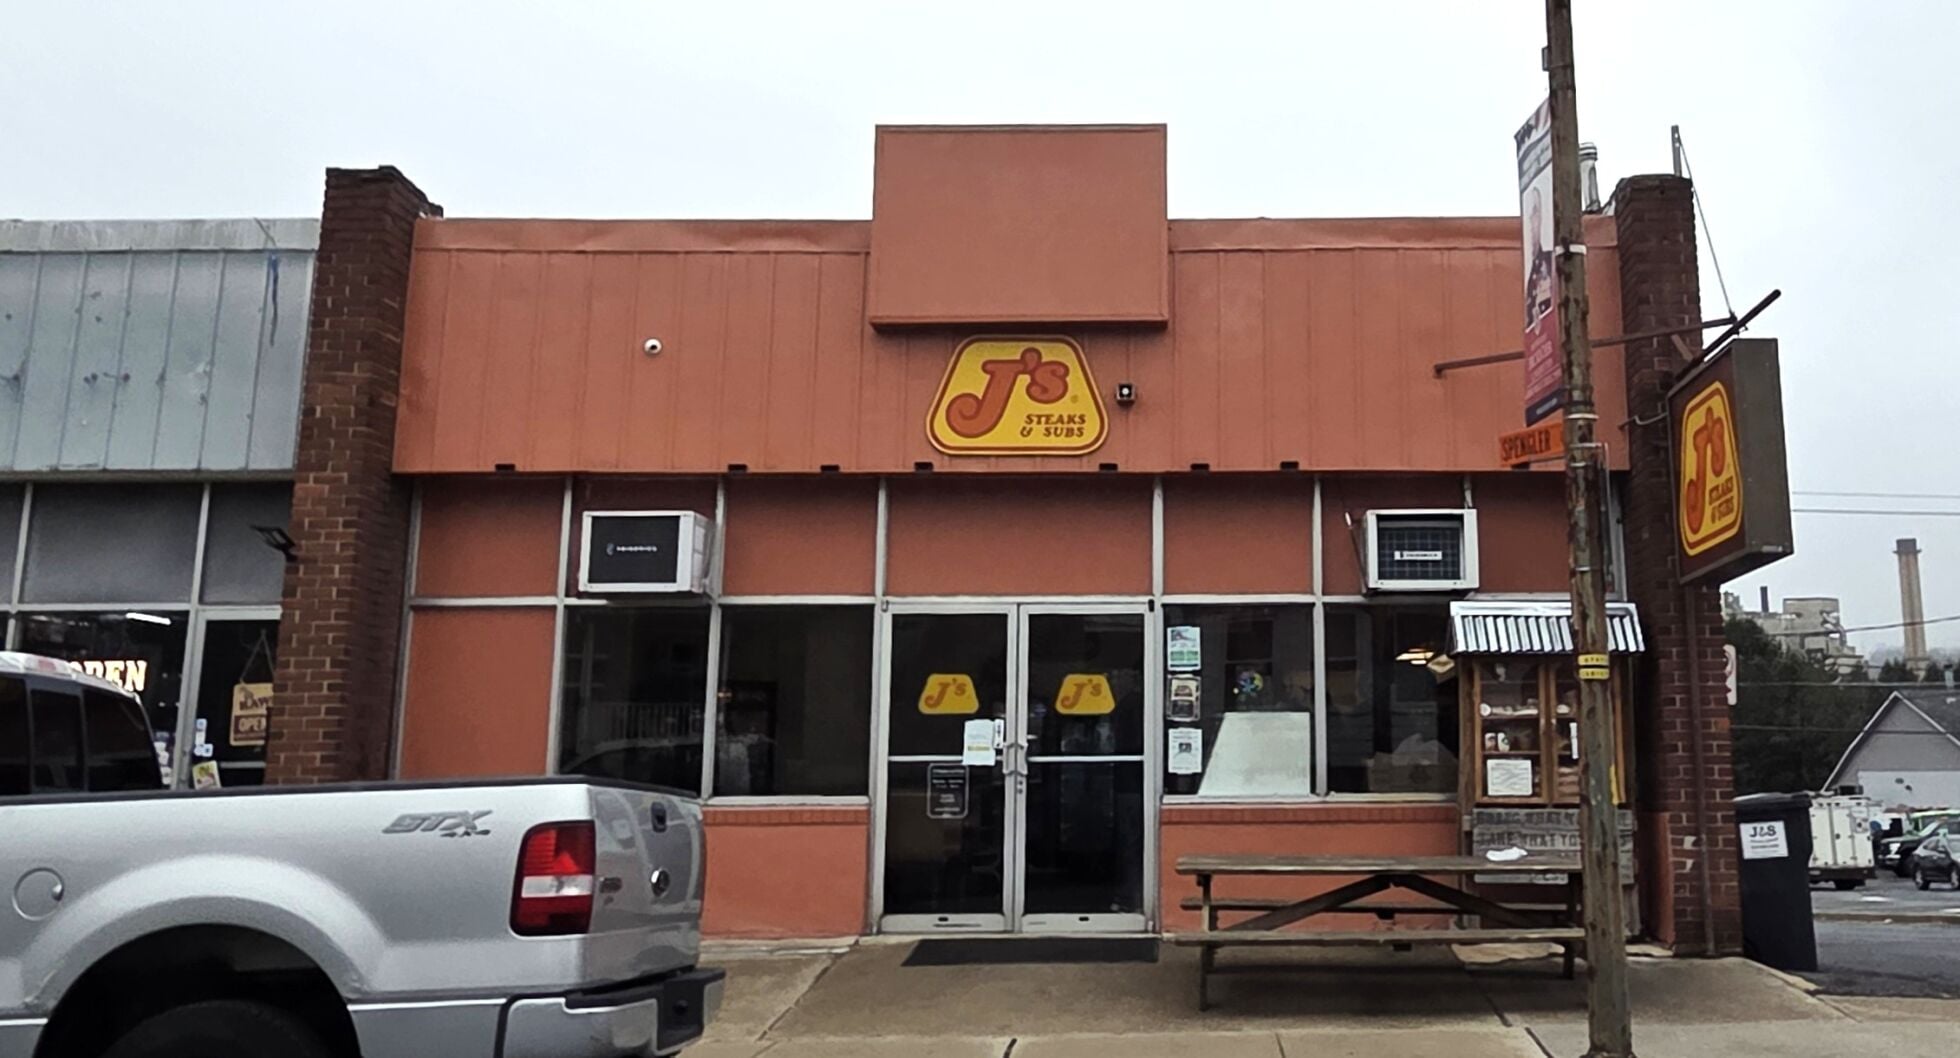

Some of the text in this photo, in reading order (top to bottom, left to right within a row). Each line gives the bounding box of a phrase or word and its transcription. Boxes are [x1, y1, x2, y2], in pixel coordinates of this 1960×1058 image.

[946, 347, 1070, 438] J's
[1020, 427, 1085, 438] & SUBS
[1024, 413, 1086, 425] STEAKS
[924, 678, 967, 708] J's
[1061, 679, 1102, 709] J's
